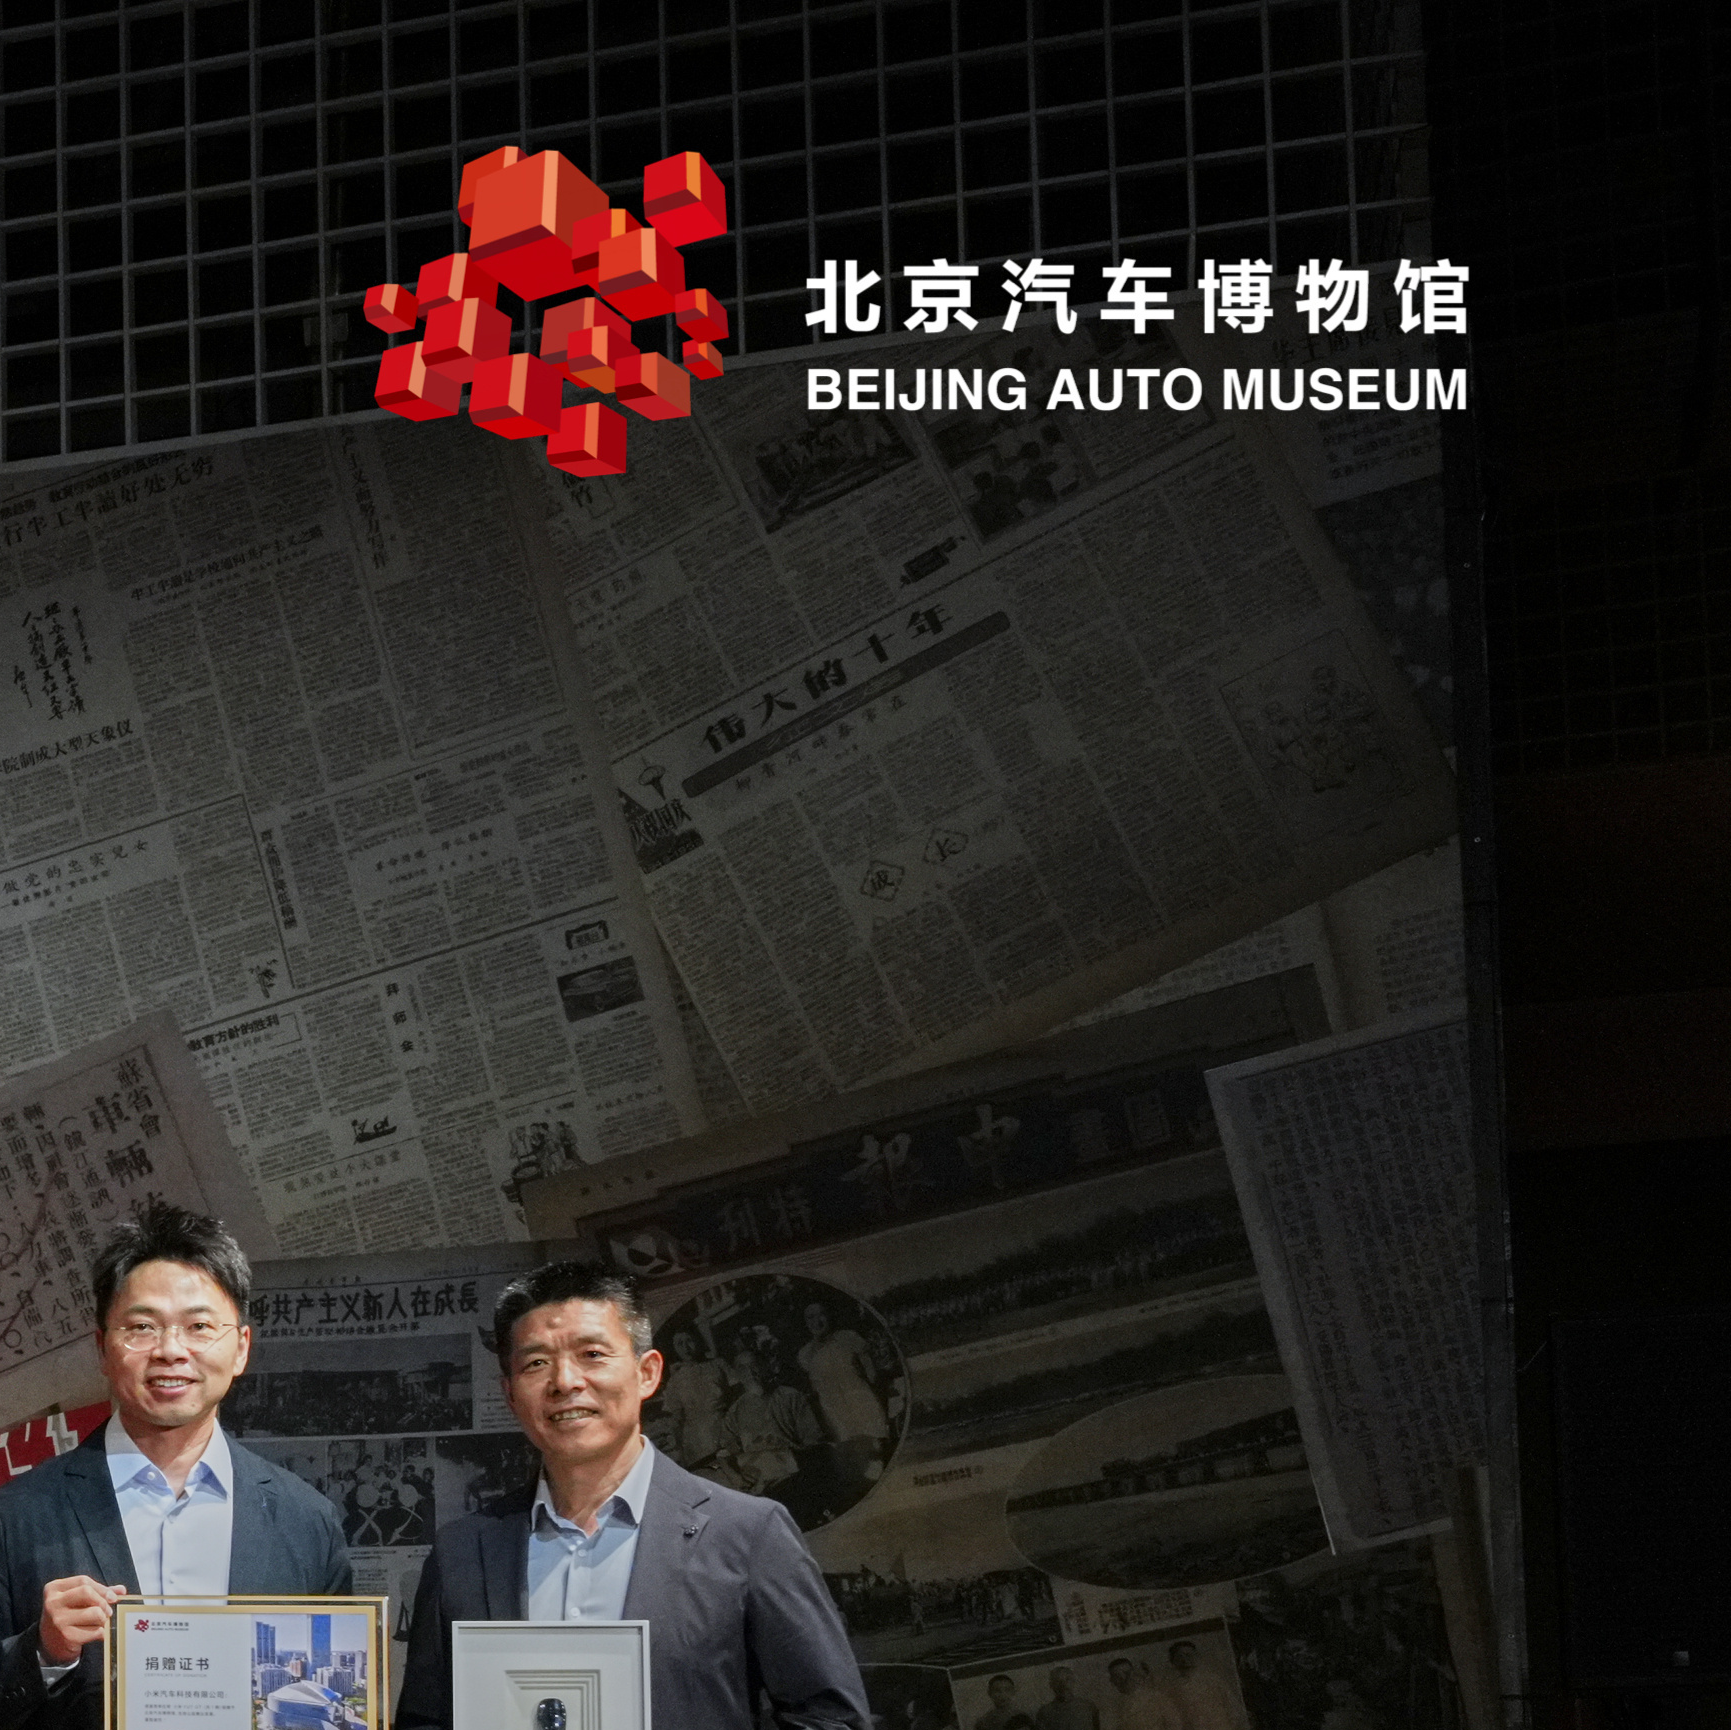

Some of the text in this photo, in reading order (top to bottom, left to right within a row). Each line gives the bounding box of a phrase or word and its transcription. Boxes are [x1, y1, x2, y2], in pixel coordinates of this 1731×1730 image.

[700, 602, 956, 756] 伟大的十年
[145, 1656, 210, 1671] 捐赠证书
